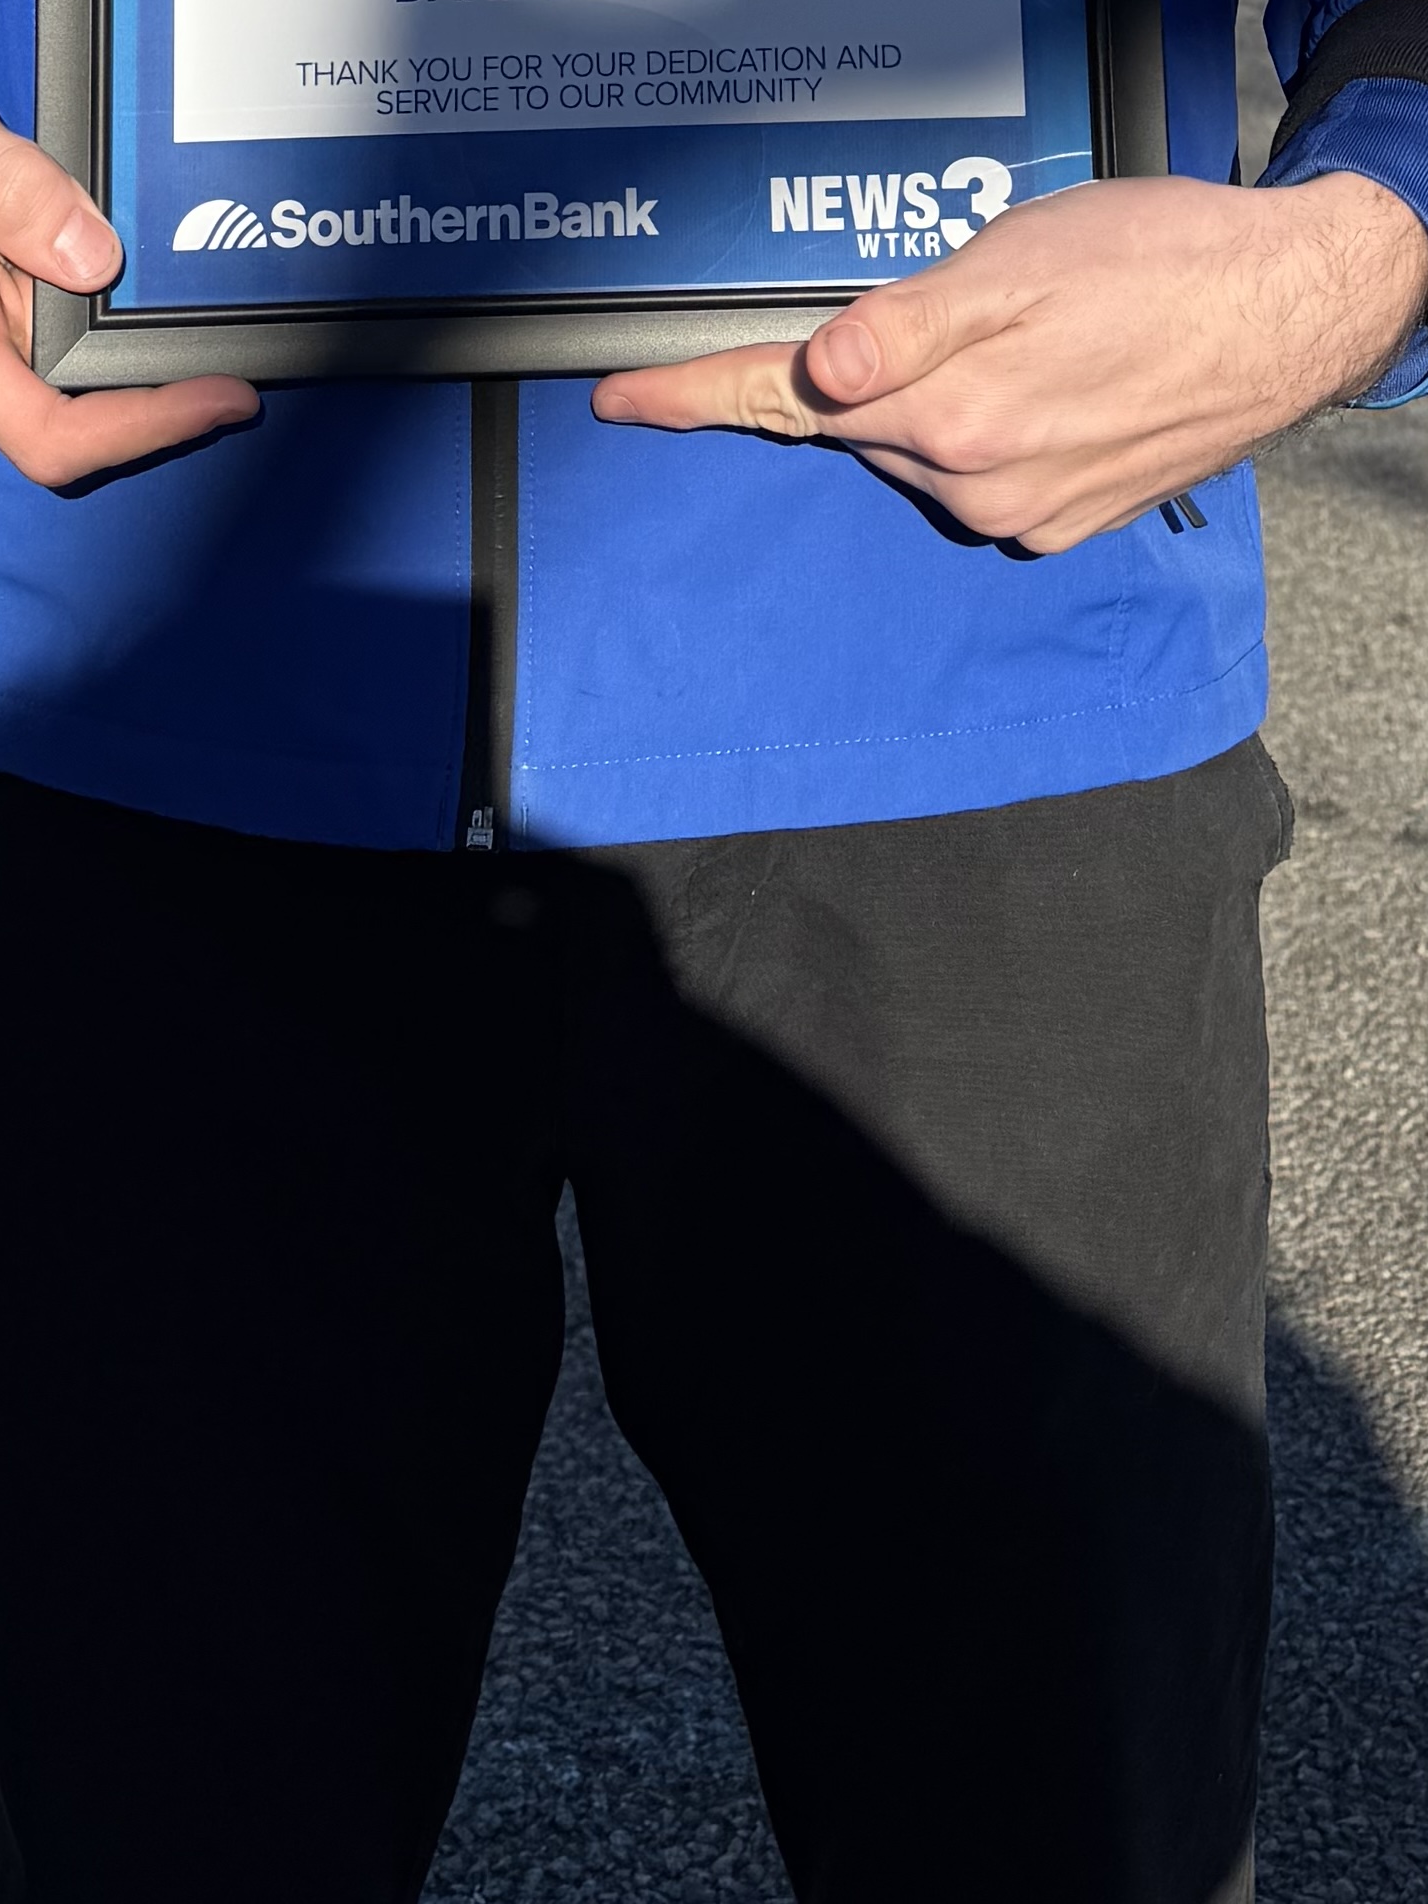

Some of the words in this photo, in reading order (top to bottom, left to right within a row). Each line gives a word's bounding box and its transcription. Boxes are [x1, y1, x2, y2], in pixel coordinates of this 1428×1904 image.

[296, 59, 399, 87] THANK
[408, 57, 472, 83] YOU
[483, 55, 543, 81] FOR
[552, 52, 635, 79] YOUR
[647, 46, 826, 75] DEDICATION
[837, 44, 902, 71] AND
[376, 87, 499, 115] SERVICE
[509, 86, 549, 111] TO
[559, 83, 624, 110] OUR
[634, 76, 823, 107] COMMUNITY
[270, 187, 659, 249] SouthernBank
[856, 231, 941, 259] WTKR
